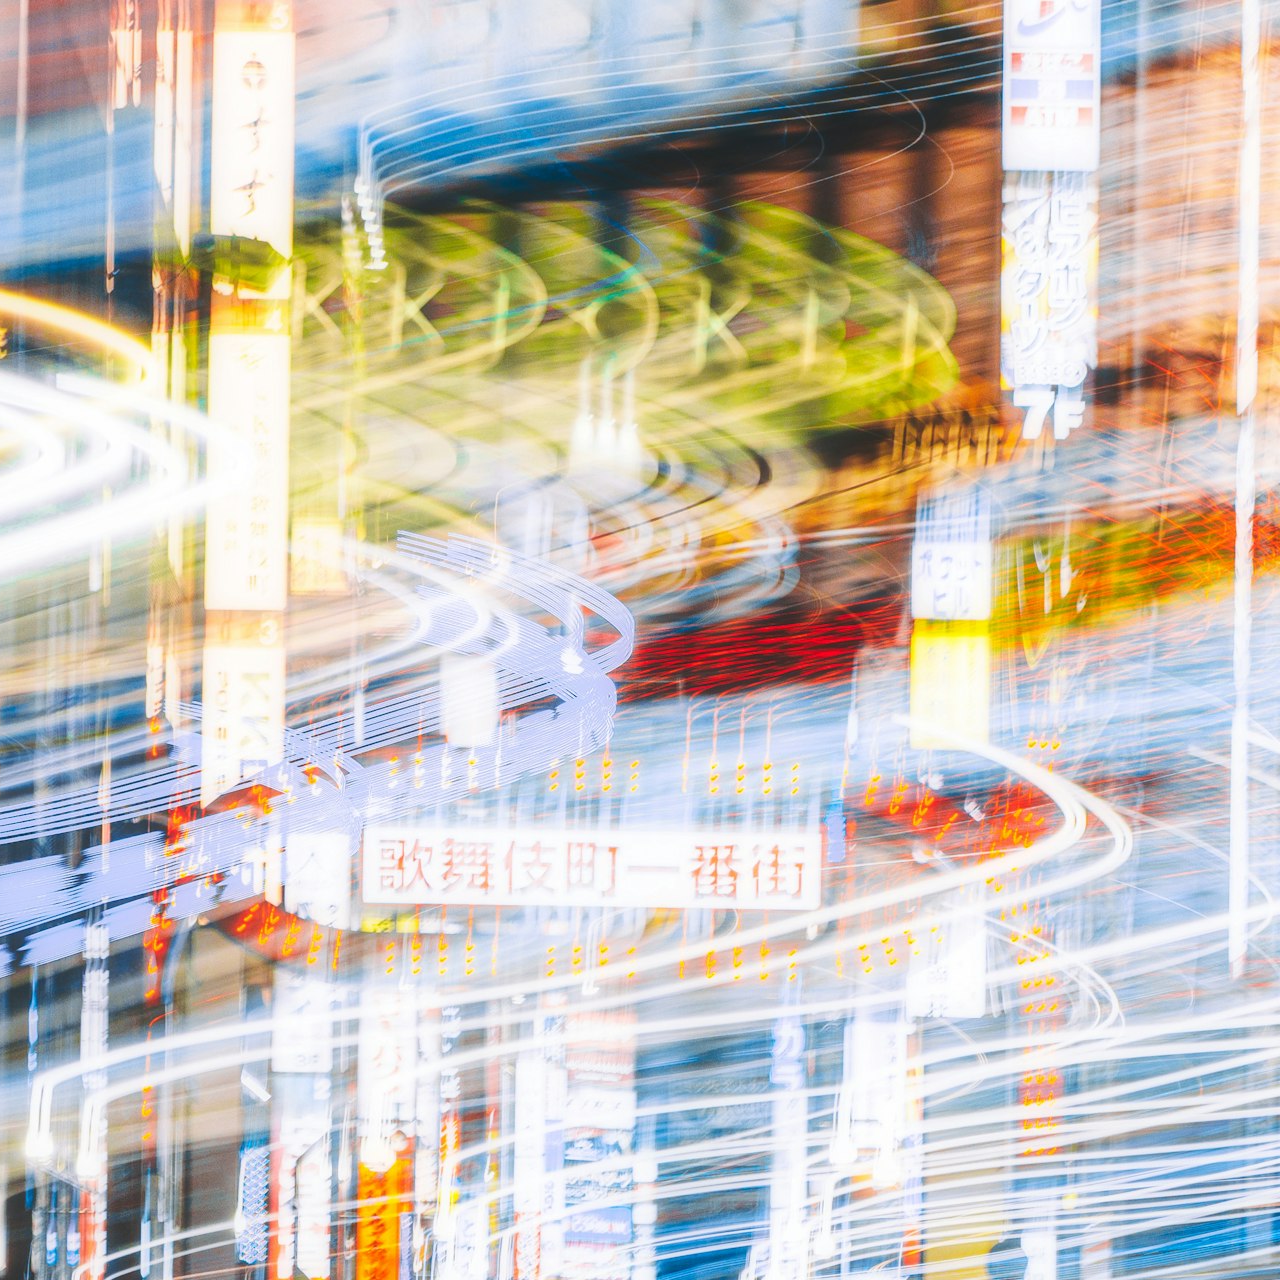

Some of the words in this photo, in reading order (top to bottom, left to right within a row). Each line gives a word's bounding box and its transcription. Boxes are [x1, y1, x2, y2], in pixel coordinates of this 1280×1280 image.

[1014, 391, 1085, 440] 7F
[378, 837, 806, 899] 歌舞伎町一番街
